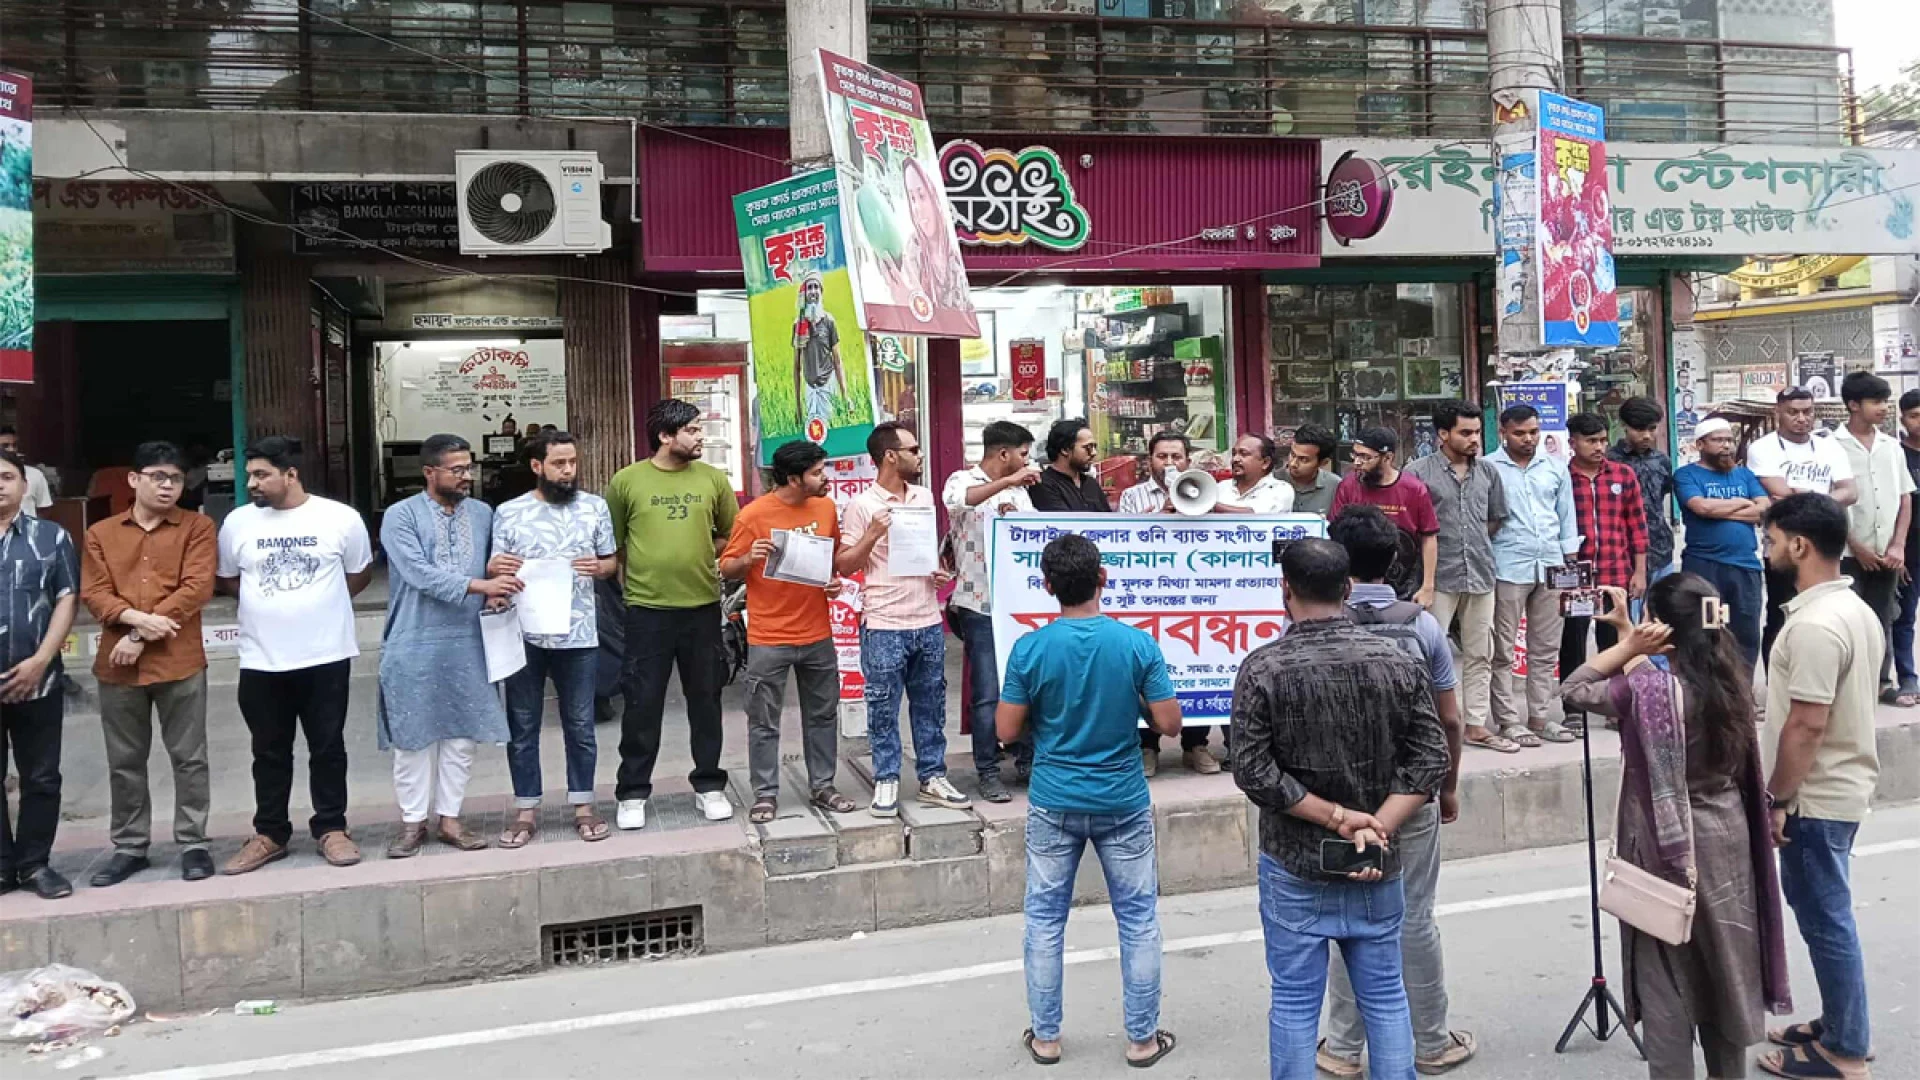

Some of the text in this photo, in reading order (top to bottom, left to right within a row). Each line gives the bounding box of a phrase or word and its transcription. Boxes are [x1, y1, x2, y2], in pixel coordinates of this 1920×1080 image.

[405, 183, 457, 200] মানব
[344, 205, 458, 219] BANGLADESH HUM
[1731, 201, 1795, 235] হাউজ
[667, 505, 688, 520] 23
[1079, 528, 1131, 543] জেলার
[1136, 525, 1167, 544] গুনি
[1173, 528, 1210, 543] ব্যান্ড
[1215, 525, 1268, 545] সংগীত
[257, 536, 317, 549] RAMONES
[1158, 576, 1191, 589] মিথ্যা
[1195, 578, 1231, 589] মামলা
[1235, 577, 1283, 589] প্রত্যাহা
[1191, 595, 1218, 606] জন্য
